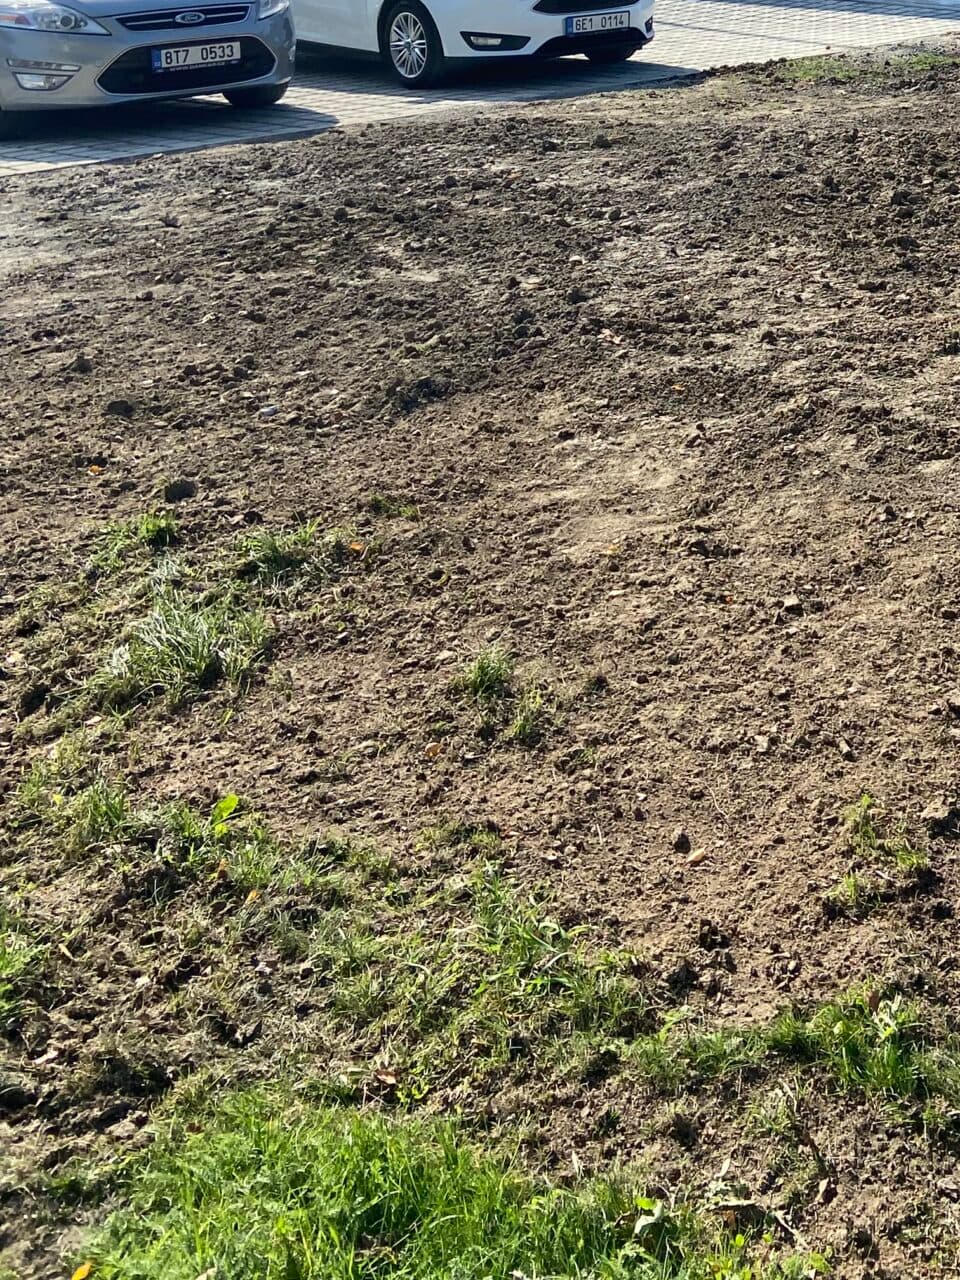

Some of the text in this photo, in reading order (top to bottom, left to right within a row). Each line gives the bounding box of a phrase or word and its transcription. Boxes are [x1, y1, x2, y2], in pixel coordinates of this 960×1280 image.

[576, 14, 624, 31] 6E1 0114
[165, 44, 234, 65] 8T7 0533
